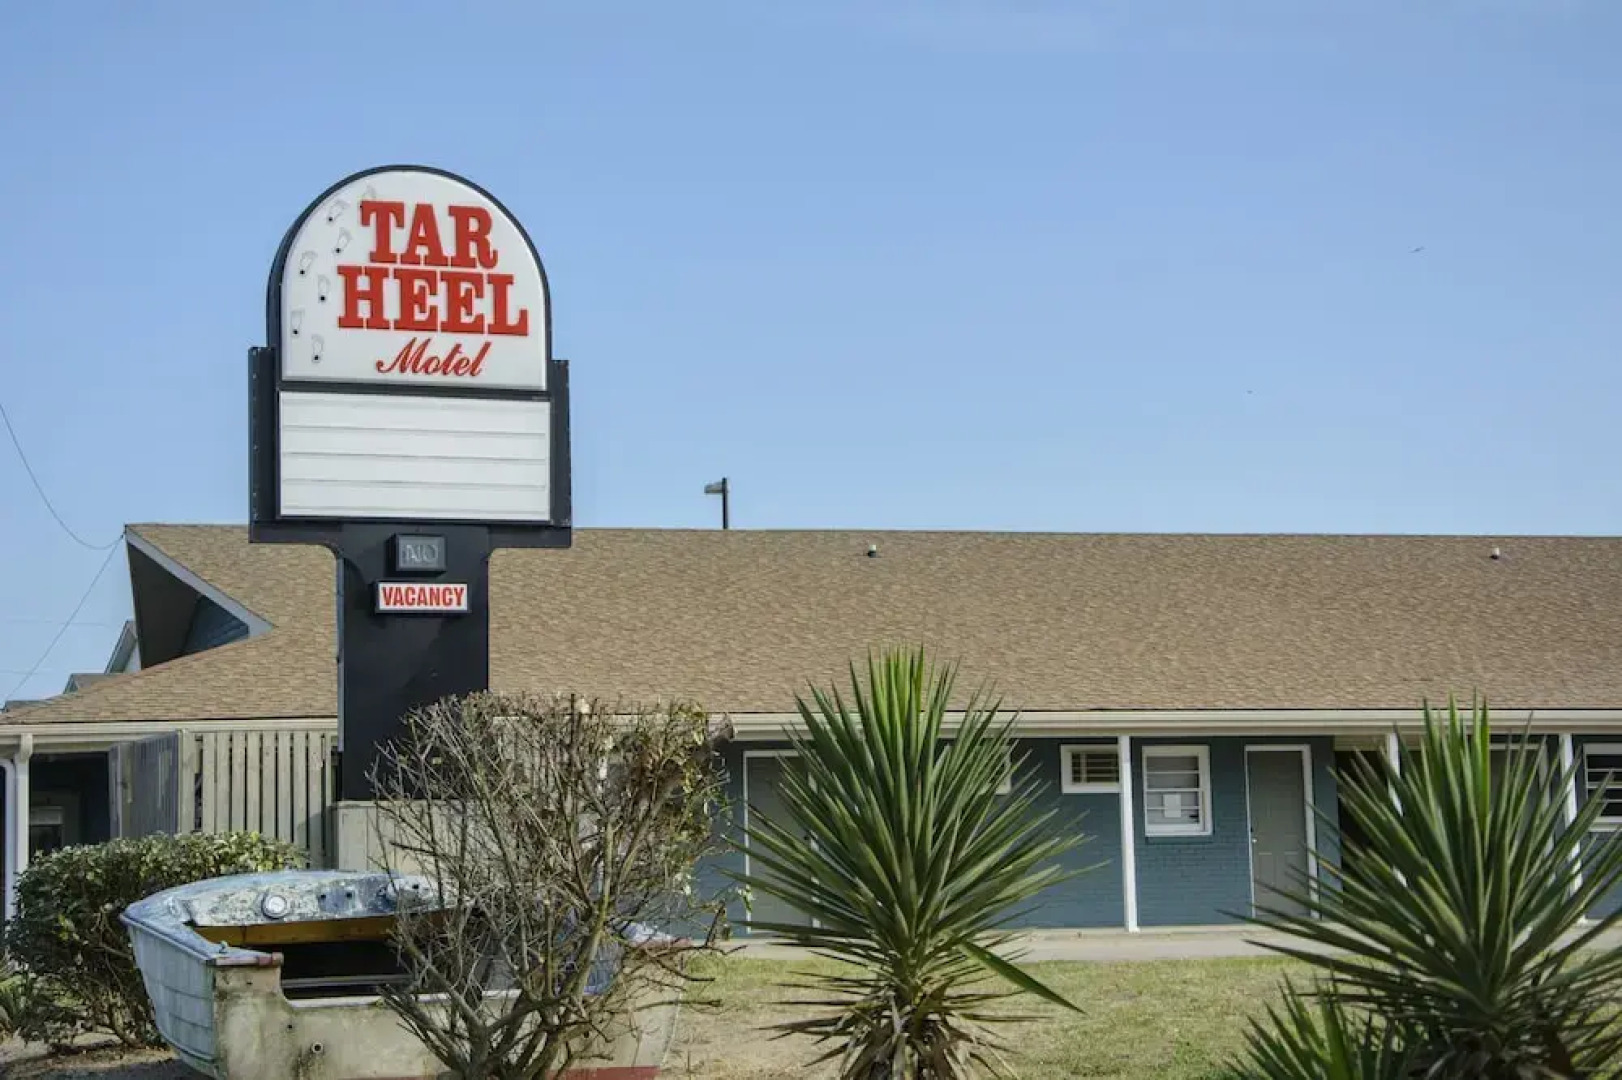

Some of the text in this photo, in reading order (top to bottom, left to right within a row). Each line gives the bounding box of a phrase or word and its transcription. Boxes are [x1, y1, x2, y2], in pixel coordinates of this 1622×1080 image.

[360, 200, 498, 269] TAR
[337, 265, 528, 336] HEEL
[375, 337, 492, 377] Motel
[405, 543, 439, 563] NO
[381, 586, 465, 607] VACANCY
